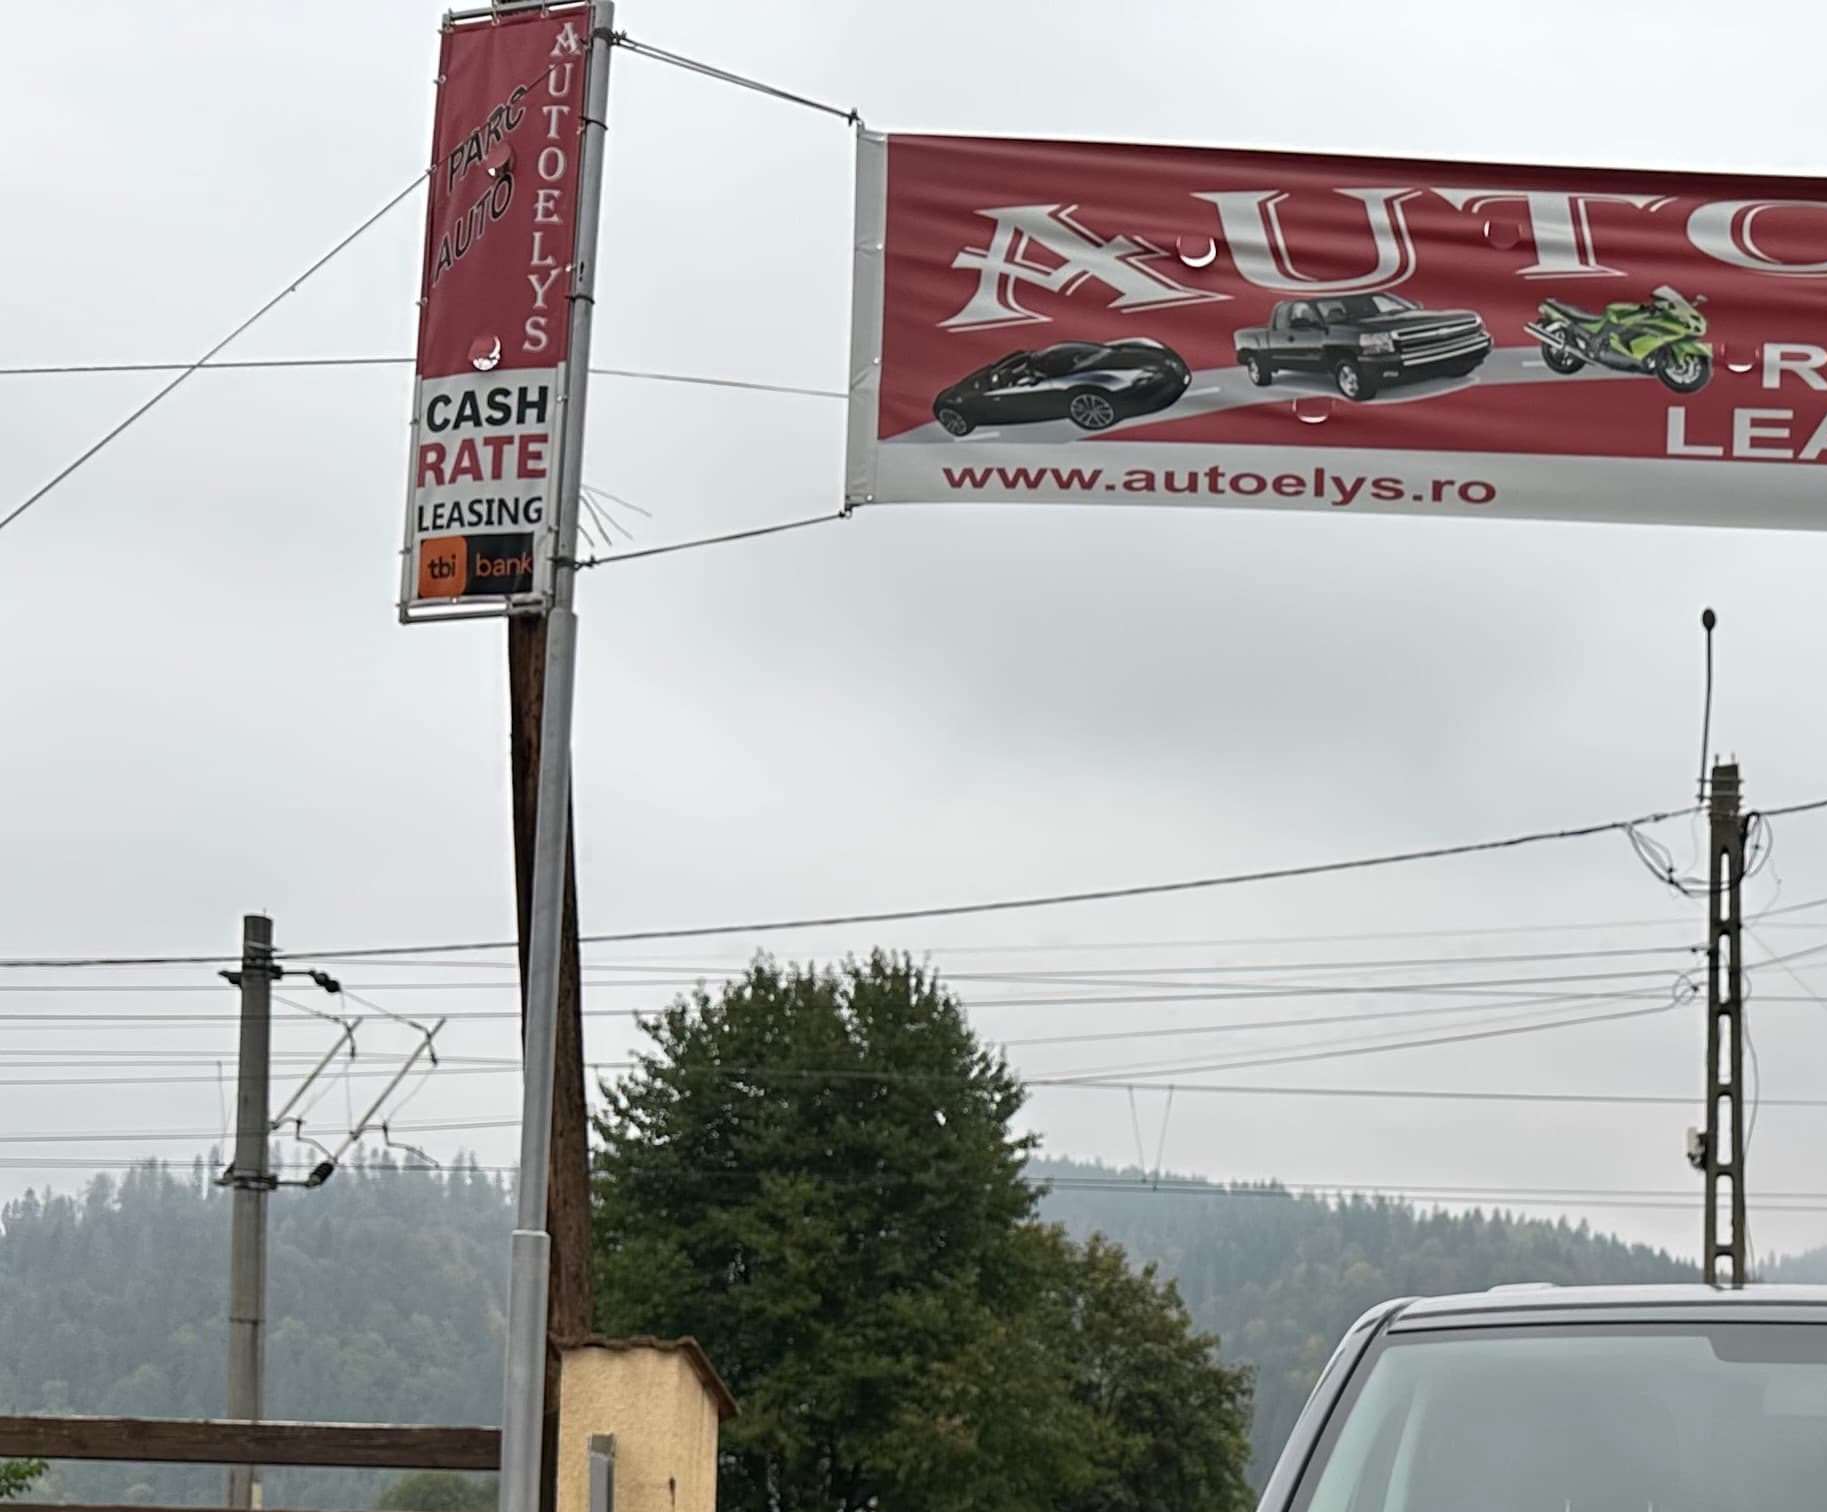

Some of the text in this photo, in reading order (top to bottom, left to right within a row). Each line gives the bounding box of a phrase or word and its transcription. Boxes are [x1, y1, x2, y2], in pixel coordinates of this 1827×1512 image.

[446, 84, 528, 194] PARC
[522, 21, 582, 354] AUTOELYS
[432, 171, 516, 285] AUTO
[426, 384, 549, 432] CASH
[416, 433, 548, 488] RATE
[941, 463, 1498, 505] www.autoelys.ro
[417, 496, 544, 533] LEASING
[428, 544, 533, 581] tbi bank
